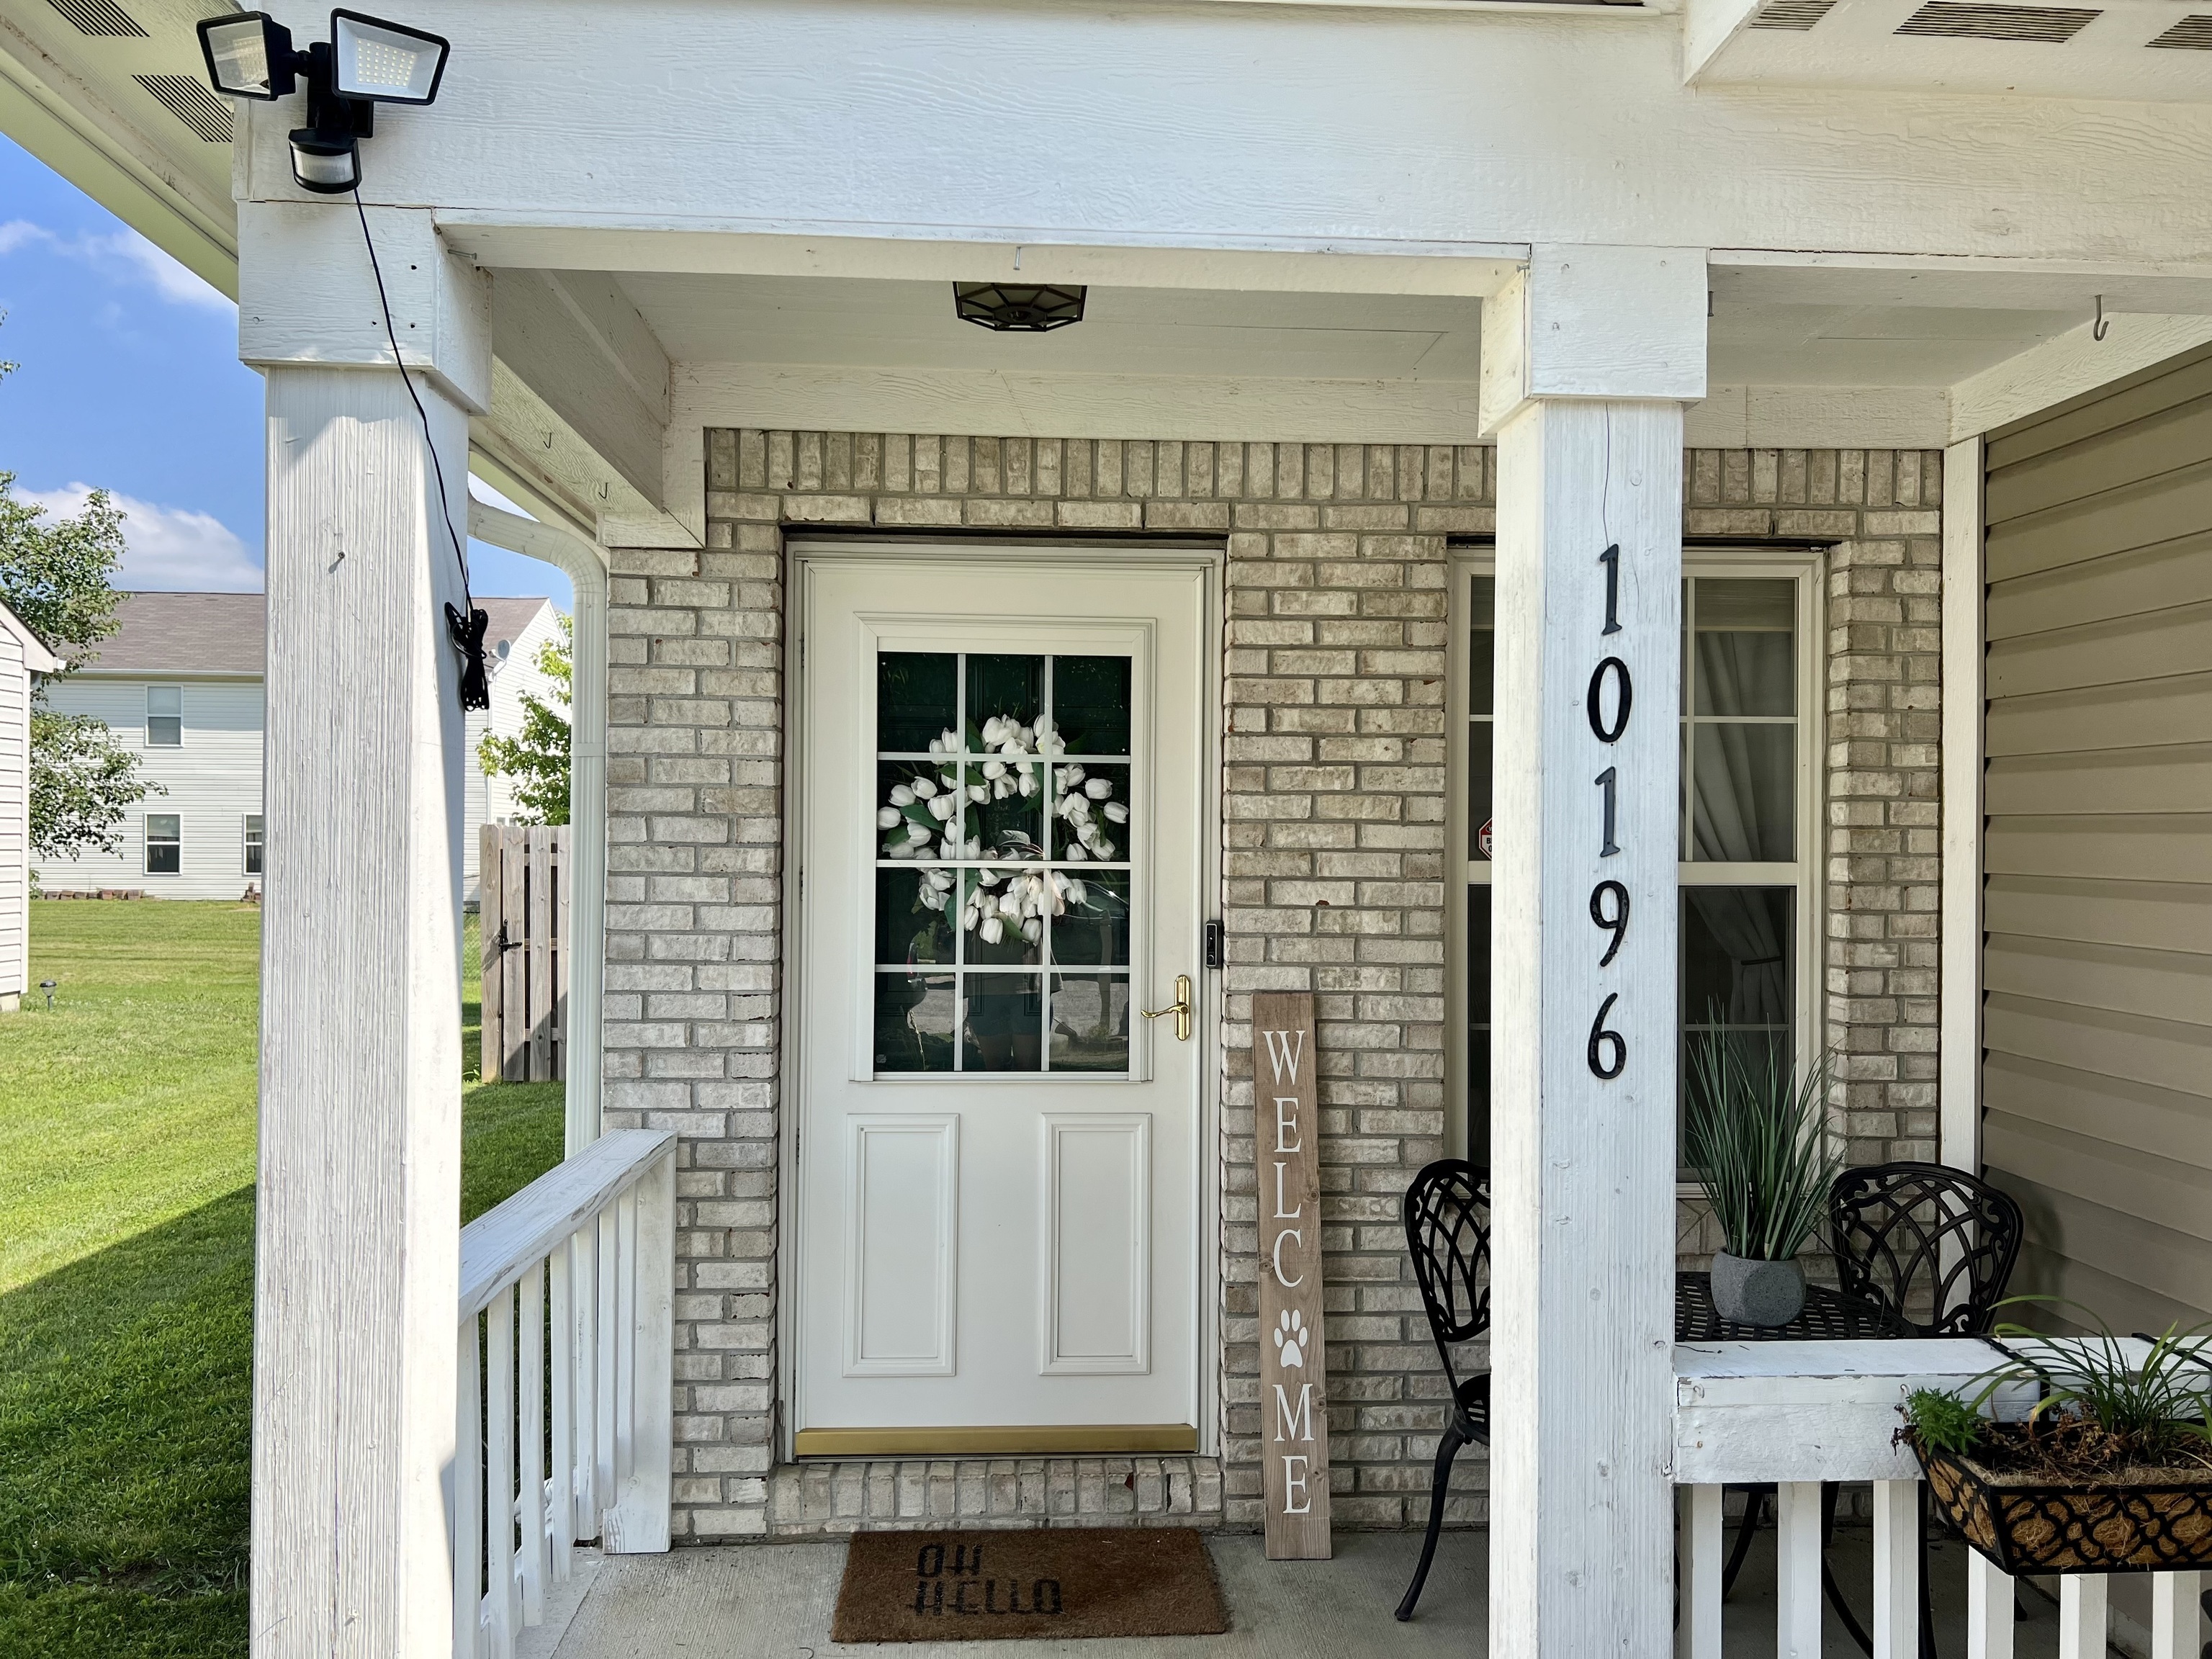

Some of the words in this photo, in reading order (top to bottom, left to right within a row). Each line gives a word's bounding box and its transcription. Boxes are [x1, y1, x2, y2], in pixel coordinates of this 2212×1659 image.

[1586, 543, 1632, 1080] 10196
[1262, 1030, 1316, 1514] WELCME
[909, 1579, 1064, 1616] HELLO
[917, 1544, 982, 1577] OH
